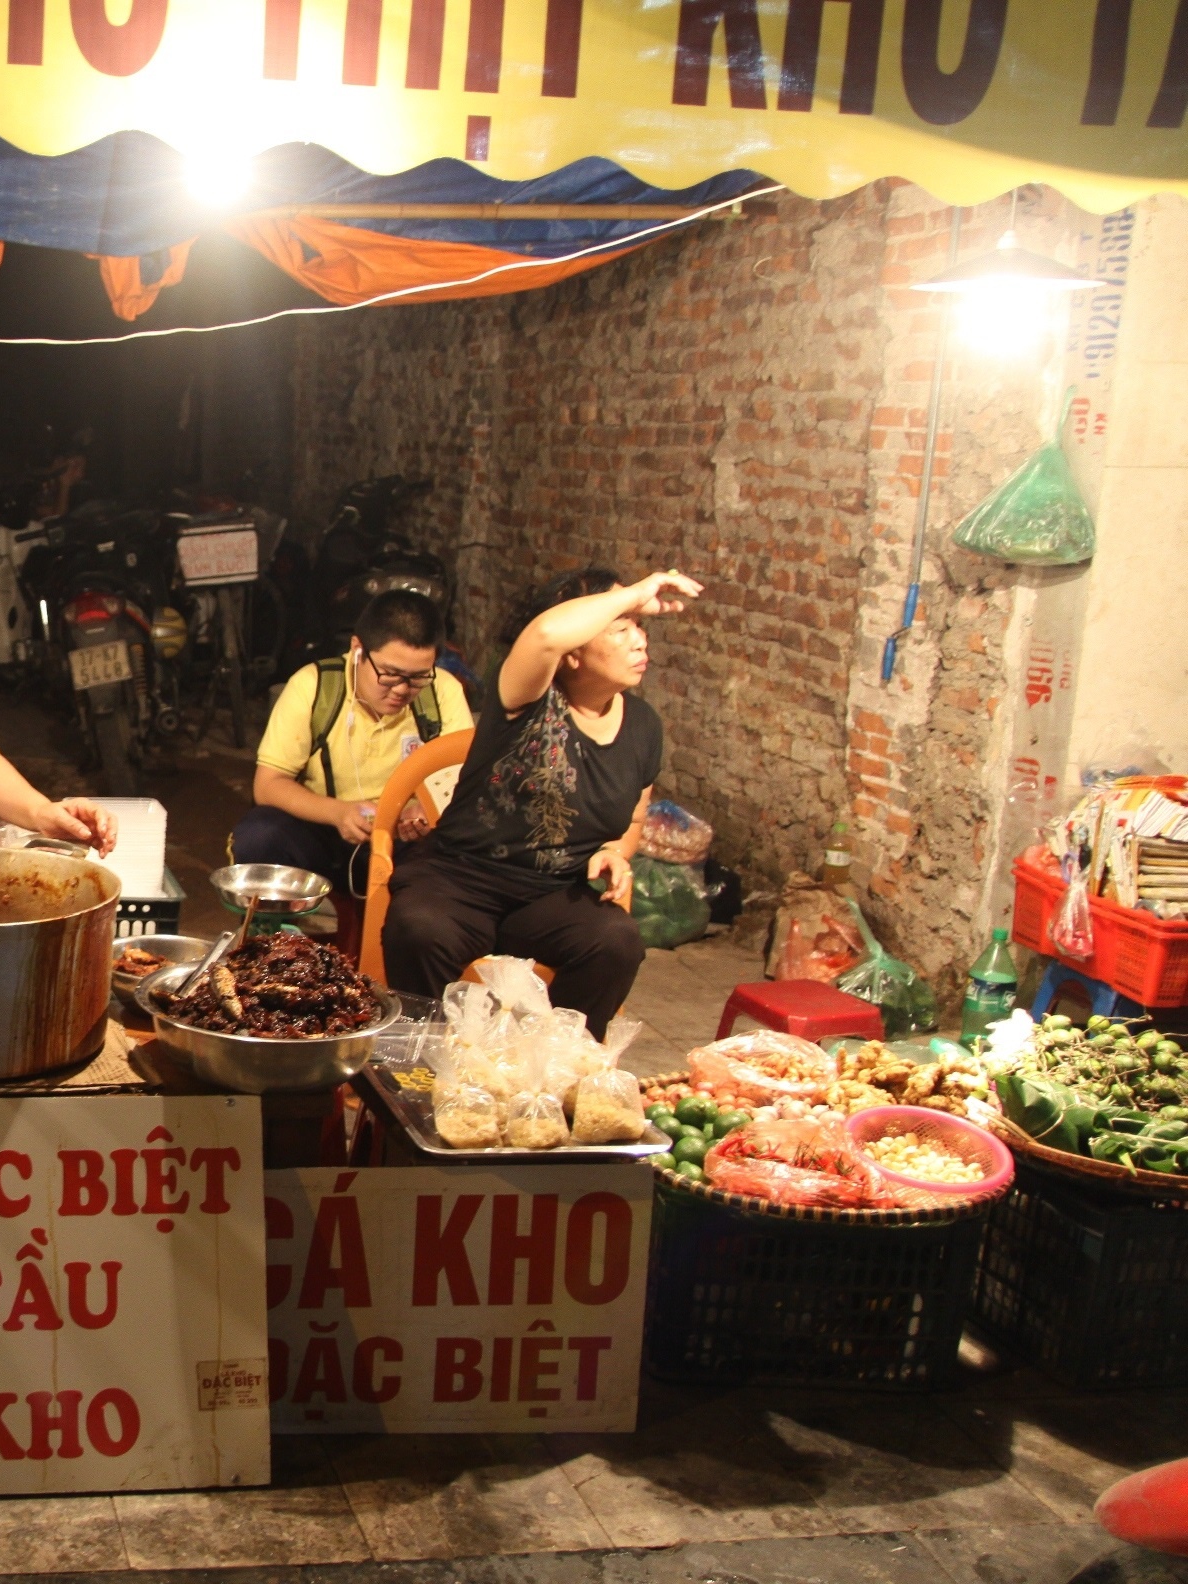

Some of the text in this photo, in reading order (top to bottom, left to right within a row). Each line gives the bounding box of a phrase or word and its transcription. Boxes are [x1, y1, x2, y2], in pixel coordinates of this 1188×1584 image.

[57, 1125, 242, 1234] BIỆT
[412, 1191, 634, 1307] KHO
[432, 1319, 612, 1418] BIỆT
